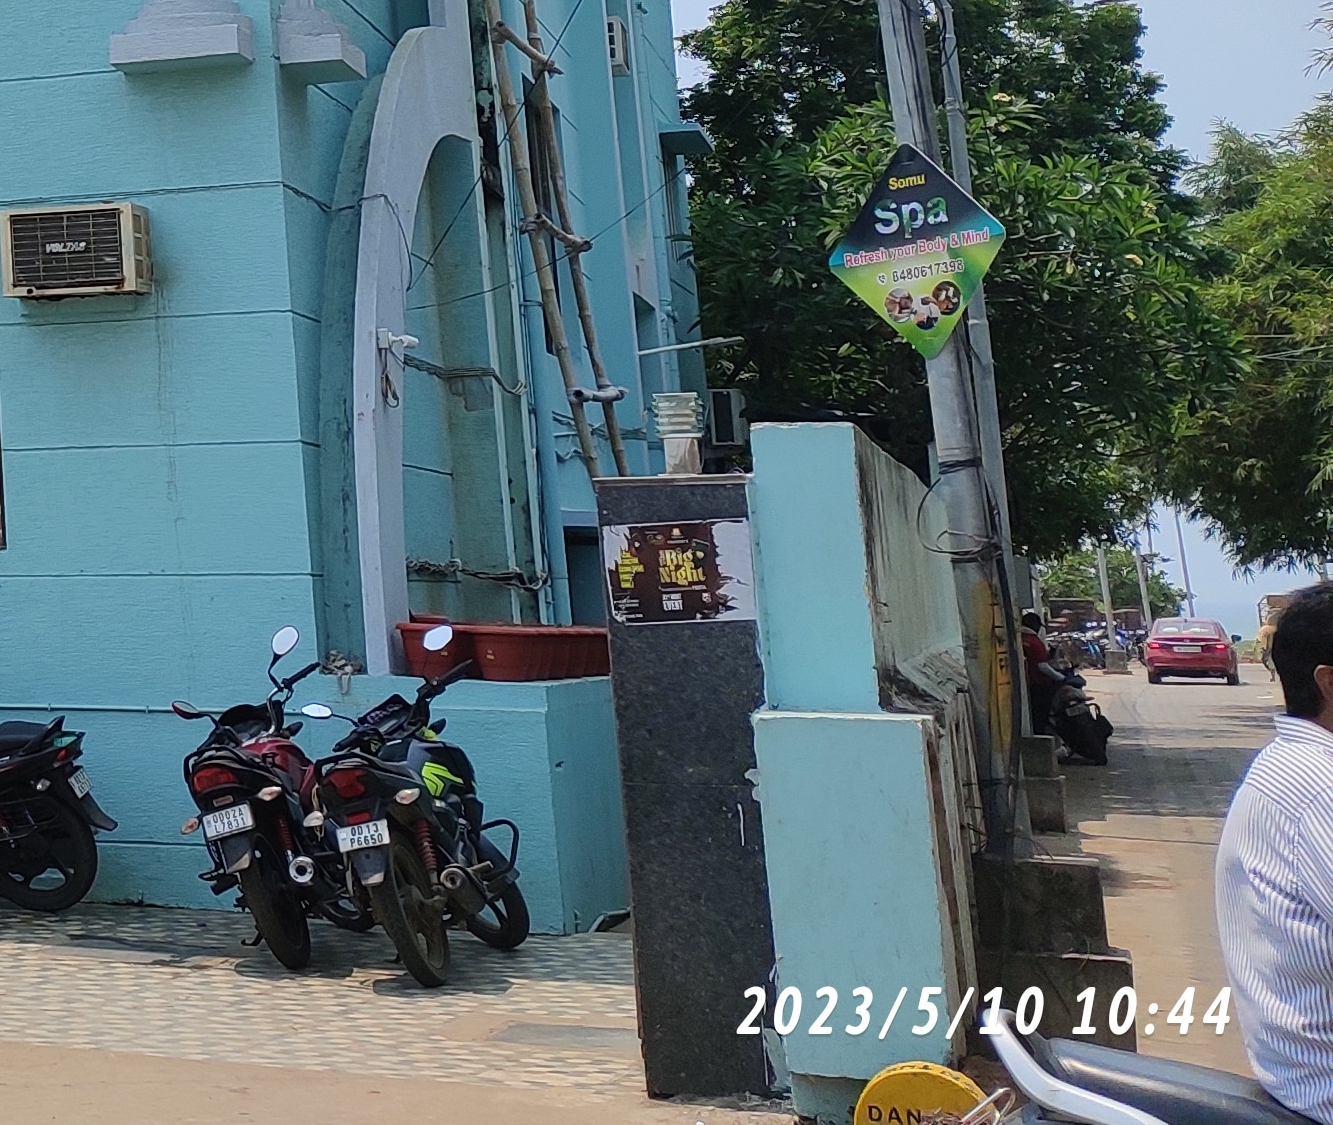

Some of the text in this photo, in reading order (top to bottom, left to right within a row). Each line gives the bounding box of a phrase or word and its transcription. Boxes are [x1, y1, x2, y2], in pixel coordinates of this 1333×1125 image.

[873, 196, 949, 239] Spa
[844, 228, 989, 267] Refresh your Body & Mind
